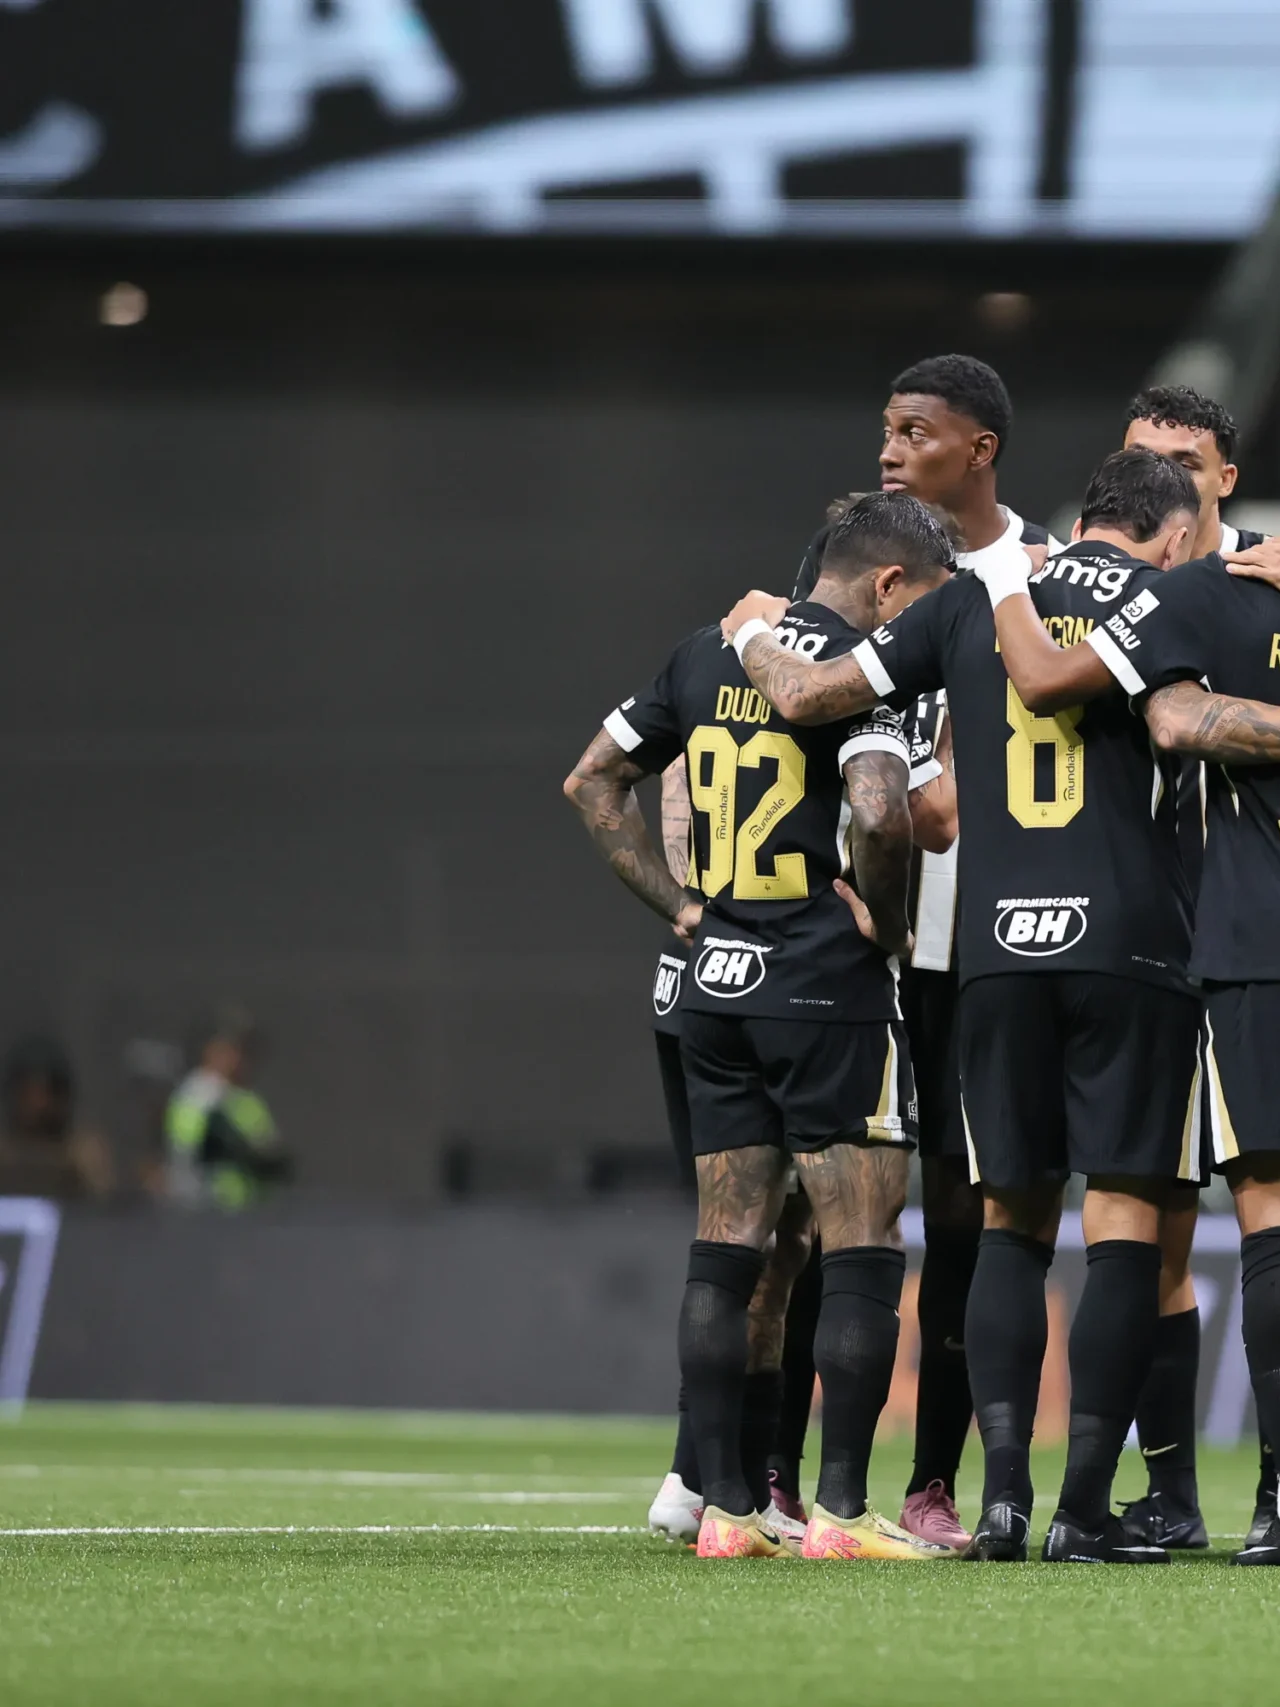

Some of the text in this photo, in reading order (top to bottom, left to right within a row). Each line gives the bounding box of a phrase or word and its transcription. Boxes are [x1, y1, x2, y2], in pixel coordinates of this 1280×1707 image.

[1006, 677, 1085, 829] 8
[1063, 744, 1076, 801] mundiale
[687, 725, 809, 900] 92
[716, 785, 729, 840] mundiale
[749, 797, 786, 840] mundiale
[996, 897, 1090, 909] SUPERMERCADOS
[1005, 910, 1072, 943] BH
[654, 967, 677, 1004] BH
[700, 950, 753, 986] BH
